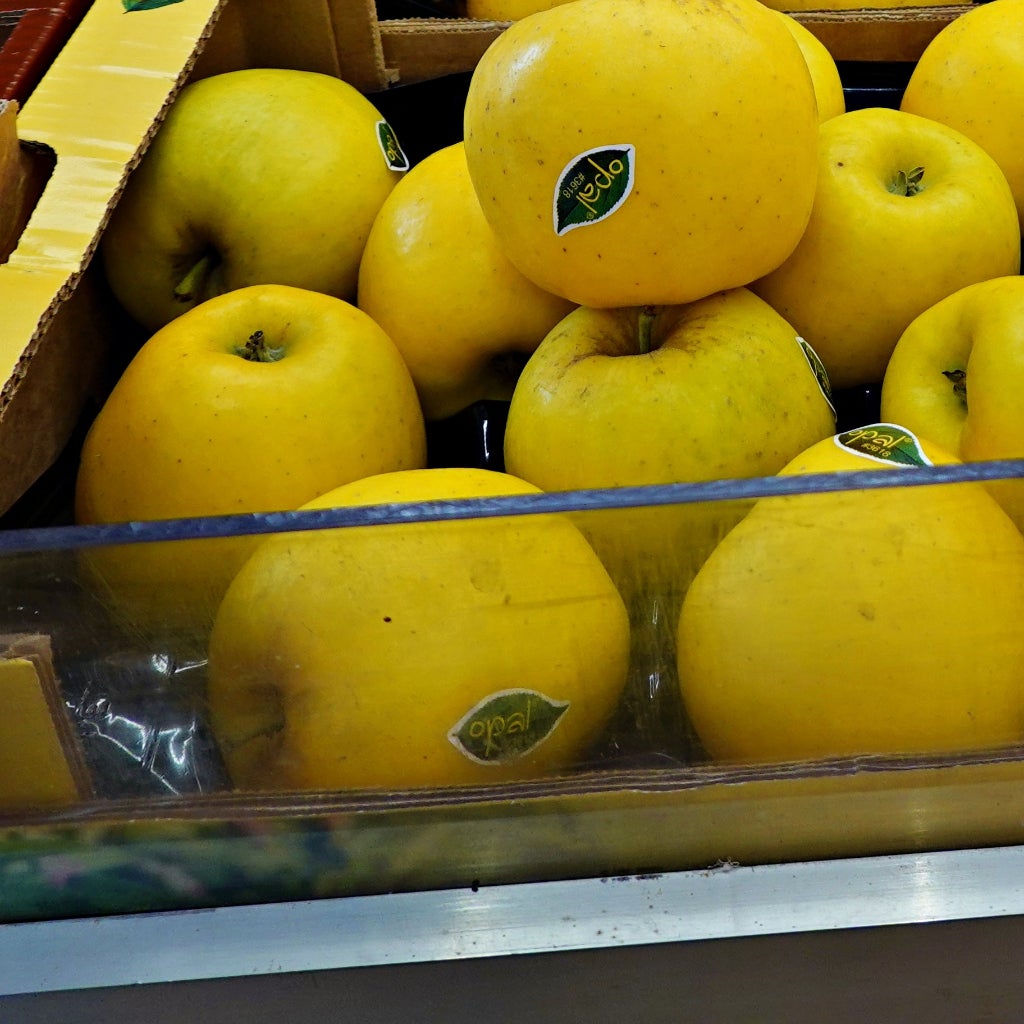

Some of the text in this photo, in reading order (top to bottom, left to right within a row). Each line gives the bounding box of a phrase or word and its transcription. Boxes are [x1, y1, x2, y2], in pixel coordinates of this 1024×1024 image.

[562, 172, 585, 199] #3618
[575, 157, 624, 214] opal
[846, 429, 906, 449] opal
[861, 443, 892, 458] #3618
[470, 698, 531, 758] opal
